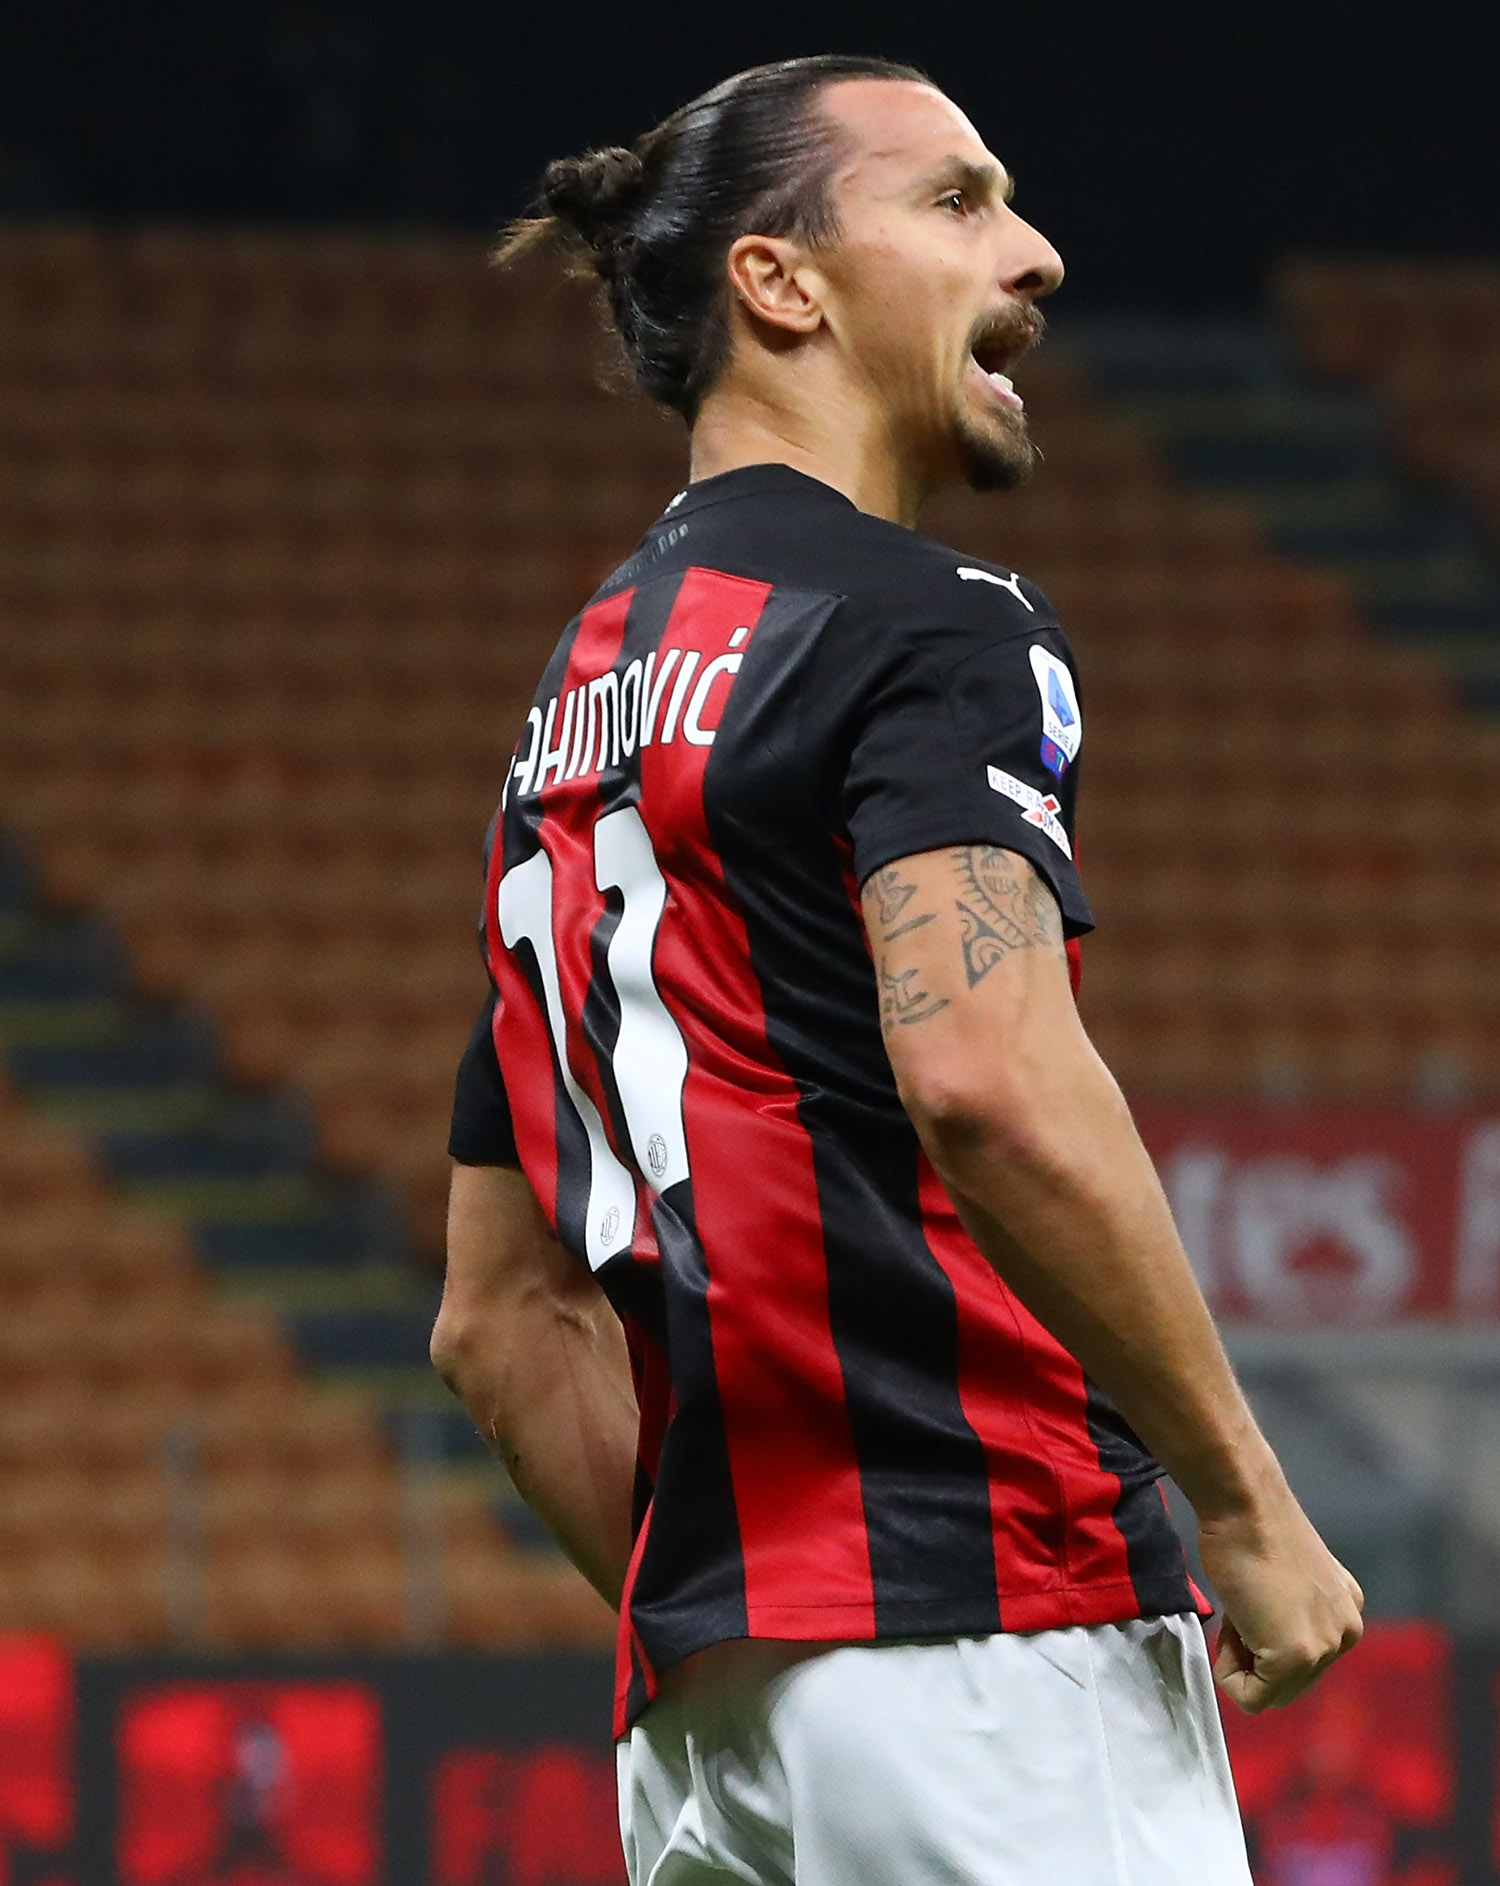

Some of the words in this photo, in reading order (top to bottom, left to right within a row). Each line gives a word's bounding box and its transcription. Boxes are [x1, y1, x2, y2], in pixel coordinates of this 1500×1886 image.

[502, 627, 748, 812] AHIMOVIĆ
[992, 773, 1022, 798] KEEP
[1026, 790, 1054, 834] RASM
[498, 806, 690, 1273] 11
